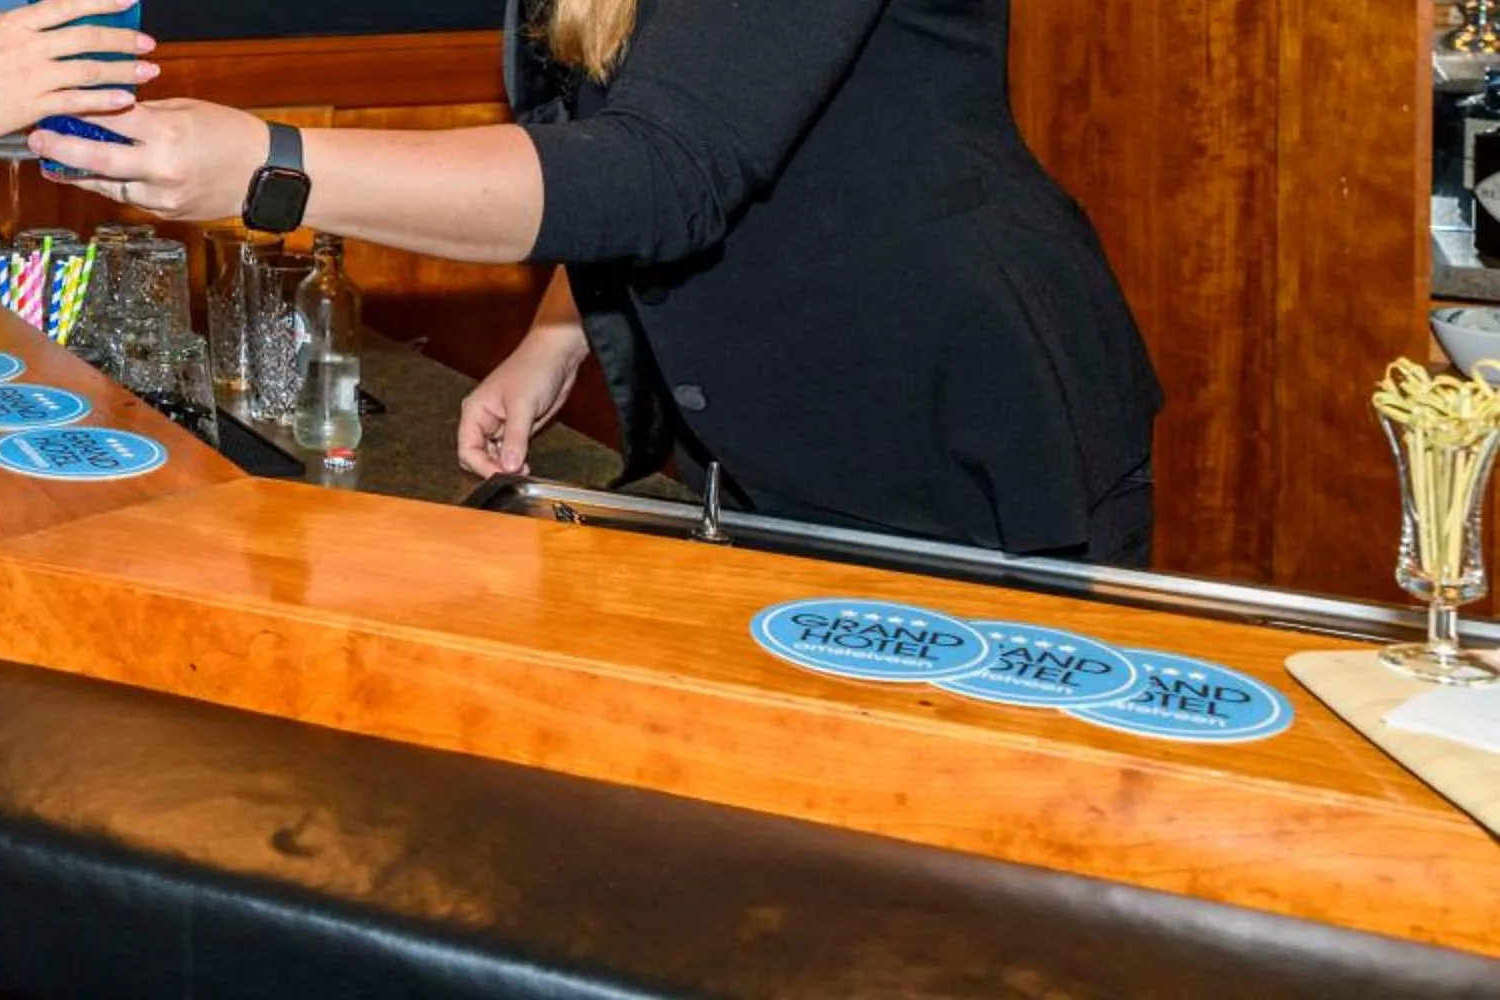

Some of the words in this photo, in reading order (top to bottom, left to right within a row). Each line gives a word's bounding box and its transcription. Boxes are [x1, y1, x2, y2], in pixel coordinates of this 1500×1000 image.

[790, 613, 964, 647] GRAND
[801, 628, 940, 661] HOTEL
[999, 646, 1112, 674] AND
[1149, 675, 1252, 703] AND
